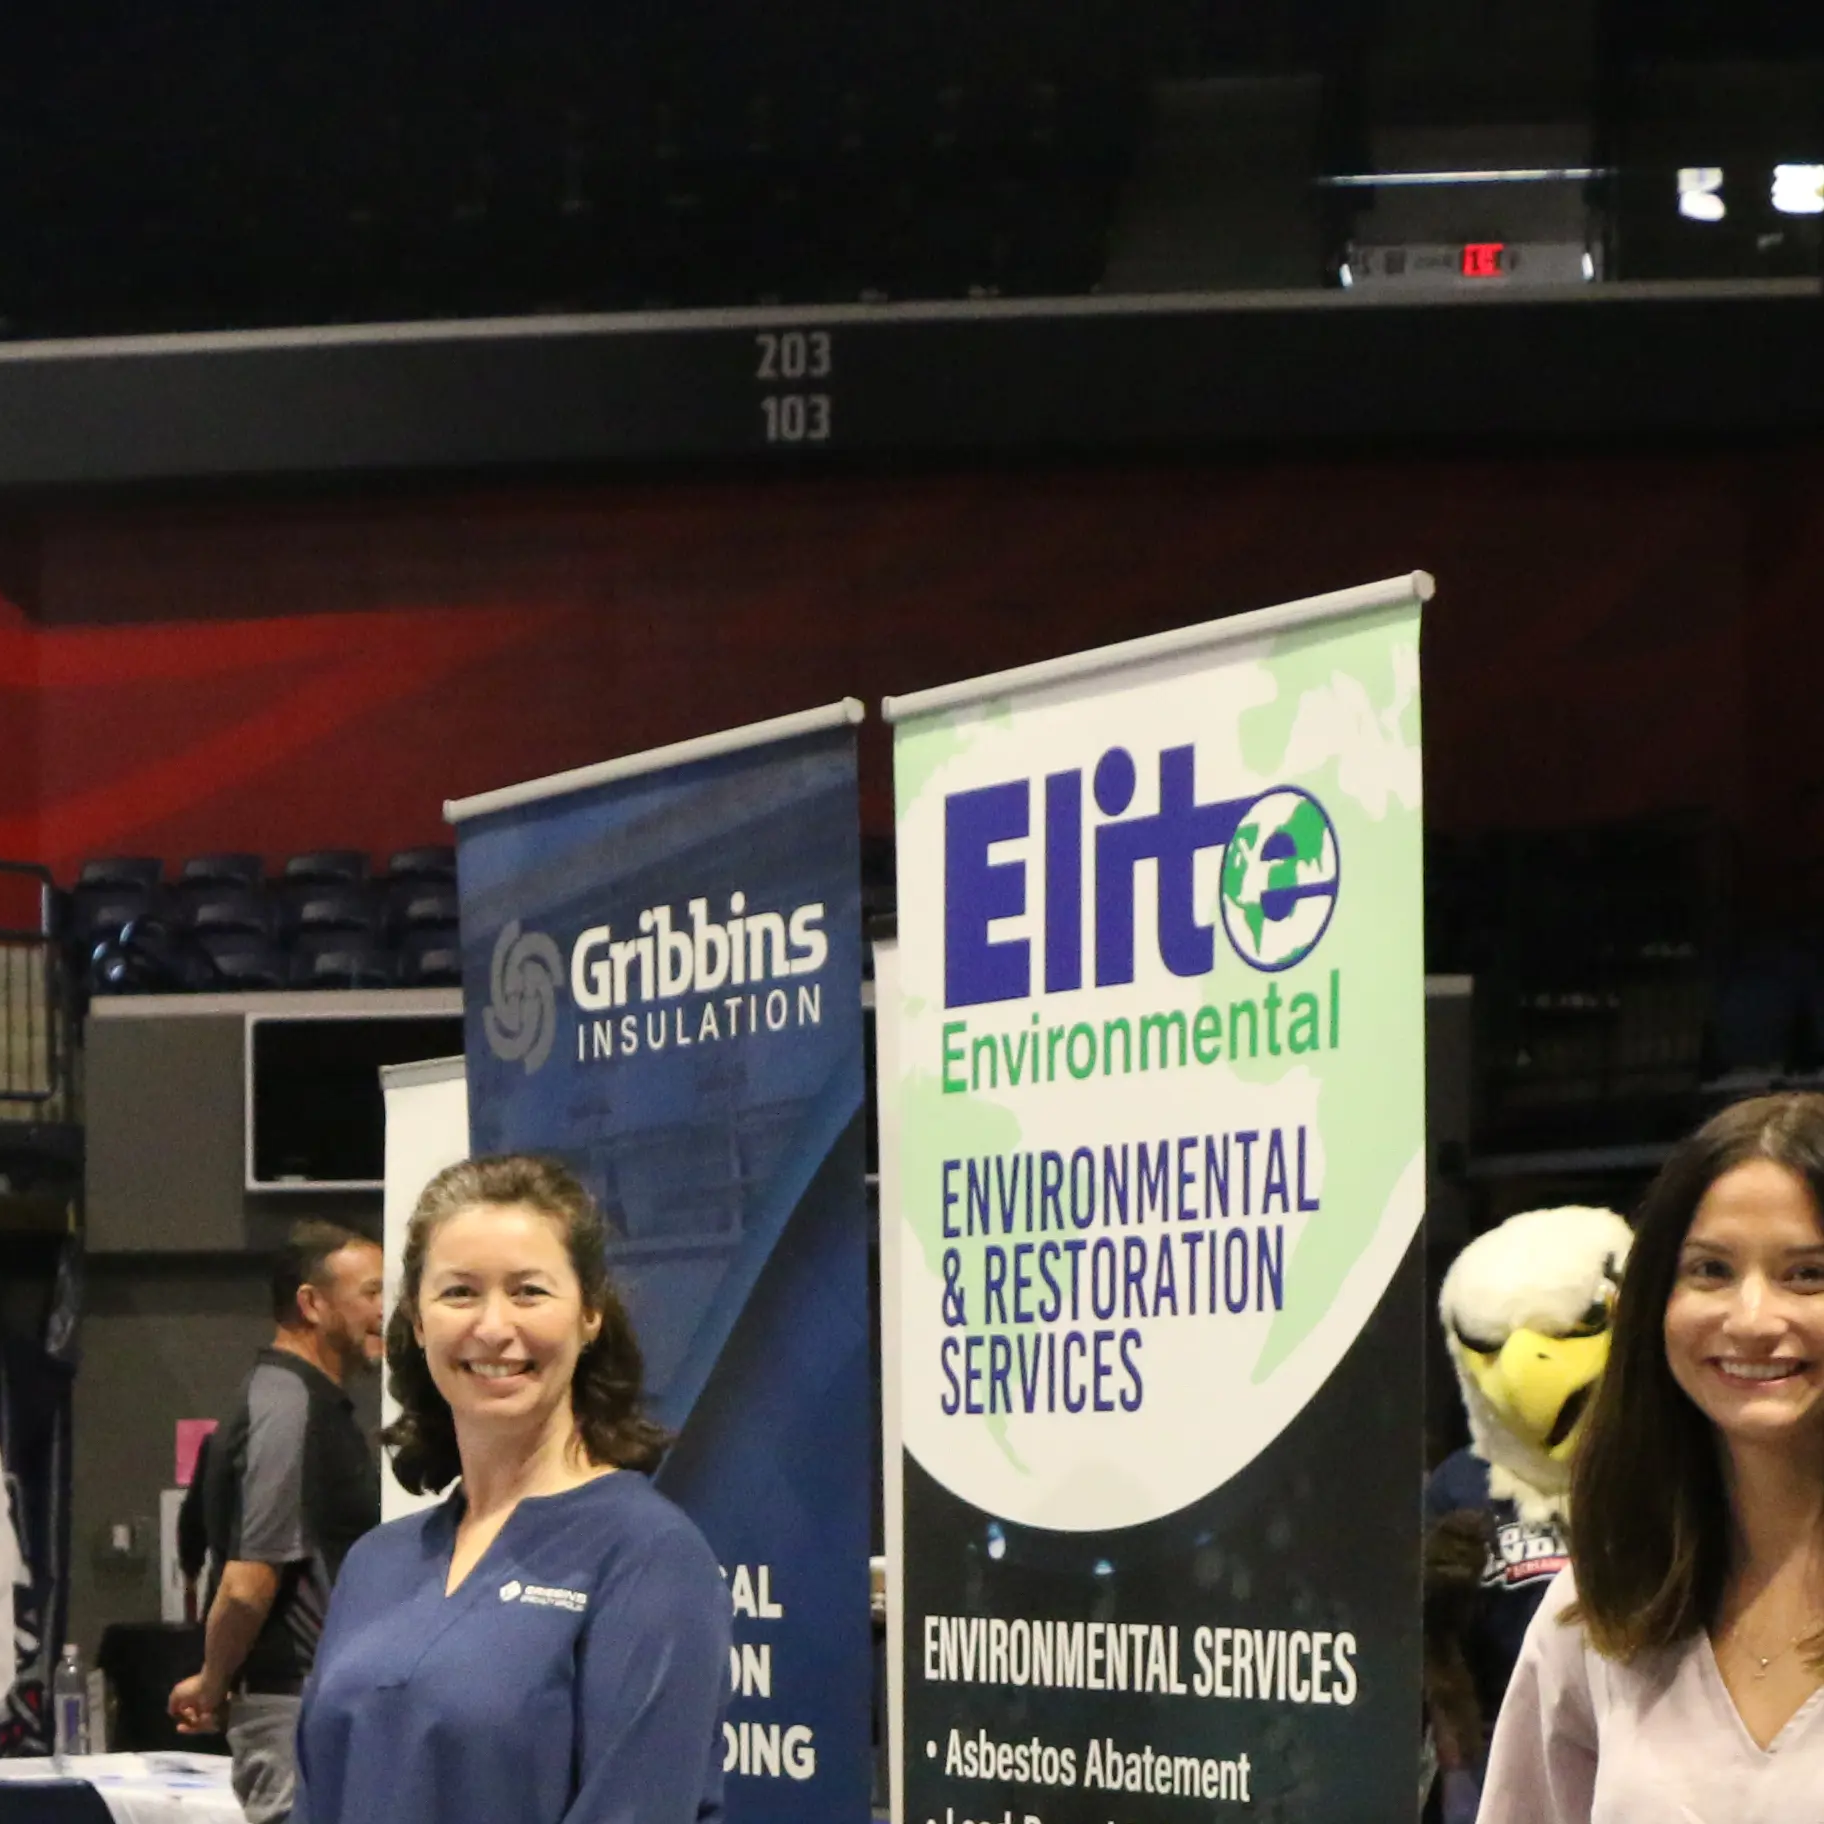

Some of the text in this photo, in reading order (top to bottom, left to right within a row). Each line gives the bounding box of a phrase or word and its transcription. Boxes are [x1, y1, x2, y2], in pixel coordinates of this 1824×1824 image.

[755, 331, 832, 379] 203
[761, 394, 831, 442] 103
[944, 743, 1339, 1008] Elite
[571, 891, 828, 1011] Gribbins
[578, 983, 822, 1062] INSULATION
[941, 968, 1341, 1094] Environmental
[941, 1125, 1320, 1240] ENVIRONMENTAL
[941, 1225, 1284, 1326] & RESTORATION
[940, 1328, 1143, 1415] SERVICES
[719, 1564, 783, 1619] AL
[924, 1615, 1357, 1706] ENVIRONMENTAL SERVICES
[945, 1729, 1250, 1803] Asbestos Abatement
